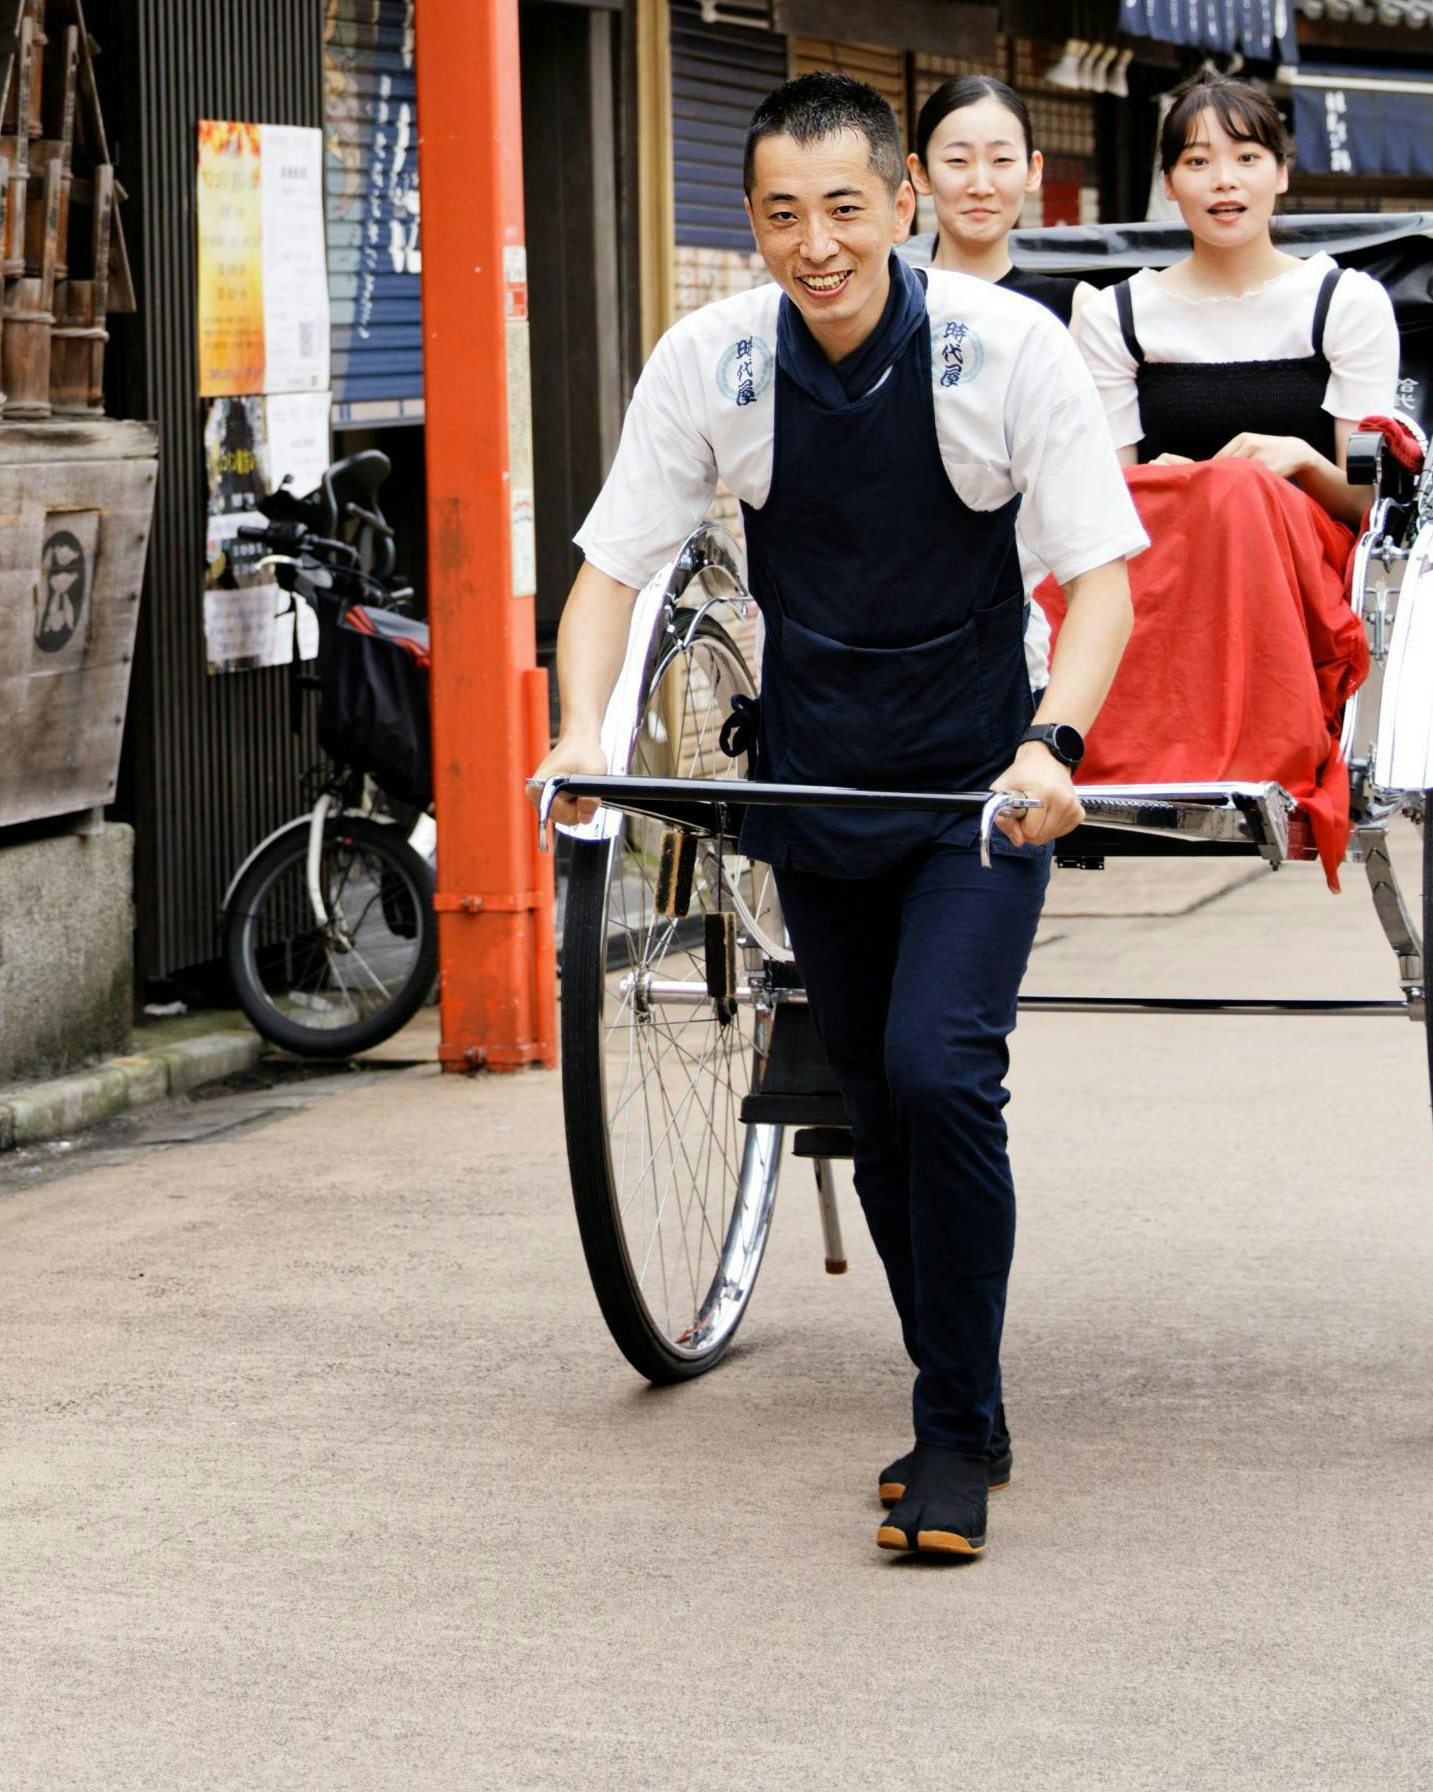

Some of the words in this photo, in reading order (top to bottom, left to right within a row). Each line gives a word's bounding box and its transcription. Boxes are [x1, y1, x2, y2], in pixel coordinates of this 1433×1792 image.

[736, 335, 758, 406] 時代屋
[939, 322, 968, 388] 時代屋
